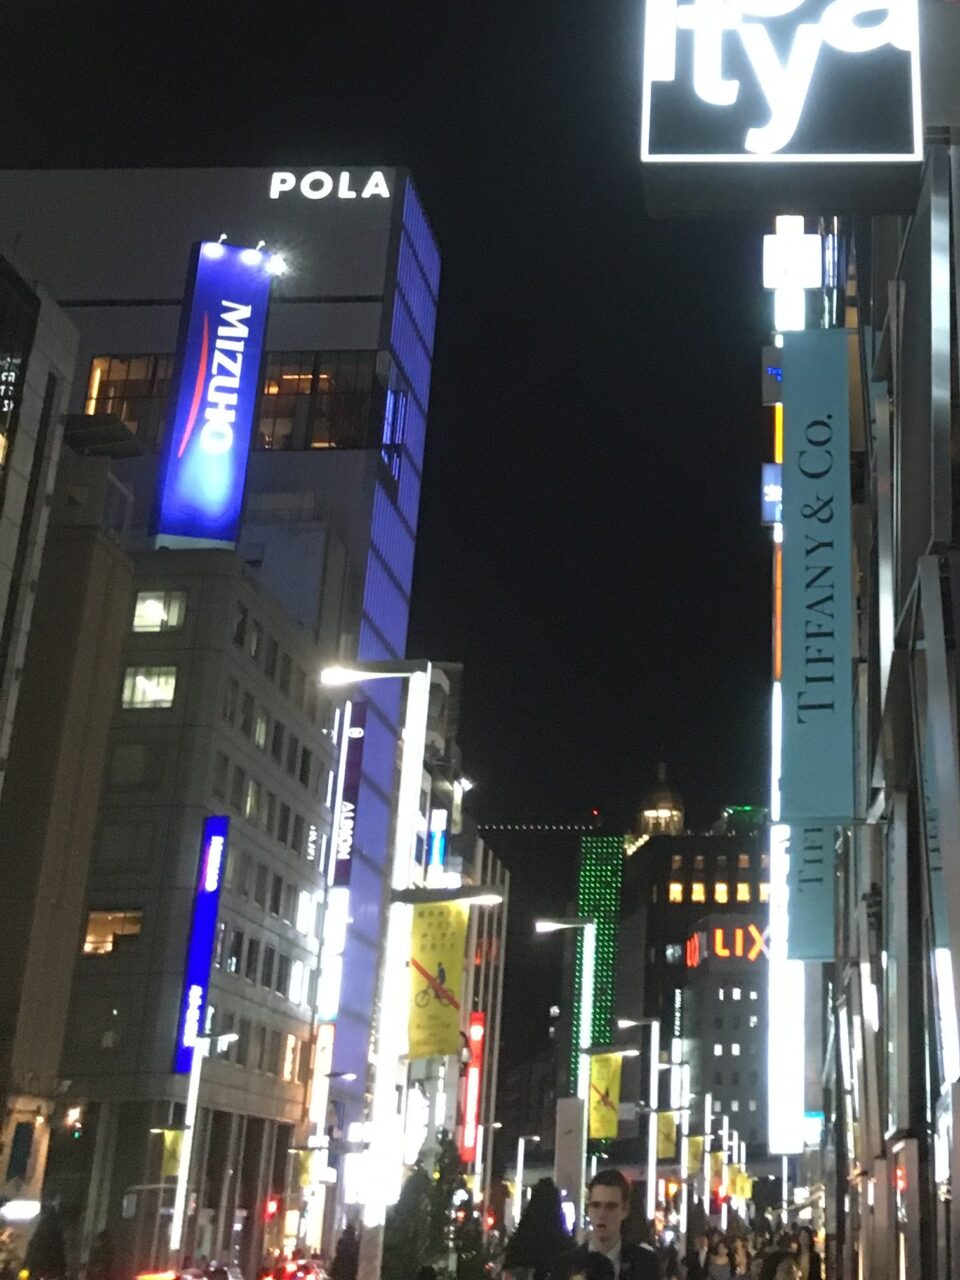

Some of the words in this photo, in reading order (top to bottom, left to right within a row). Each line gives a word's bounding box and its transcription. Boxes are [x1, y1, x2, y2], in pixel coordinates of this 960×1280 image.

[270, 171, 391, 199] POLA
[200, 299, 252, 454] MIZUHO
[797, 414, 834, 480] CO.
[801, 494, 834, 524] &
[797, 534, 835, 724] TIFFANY
[336, 800, 355, 860] ALBION
